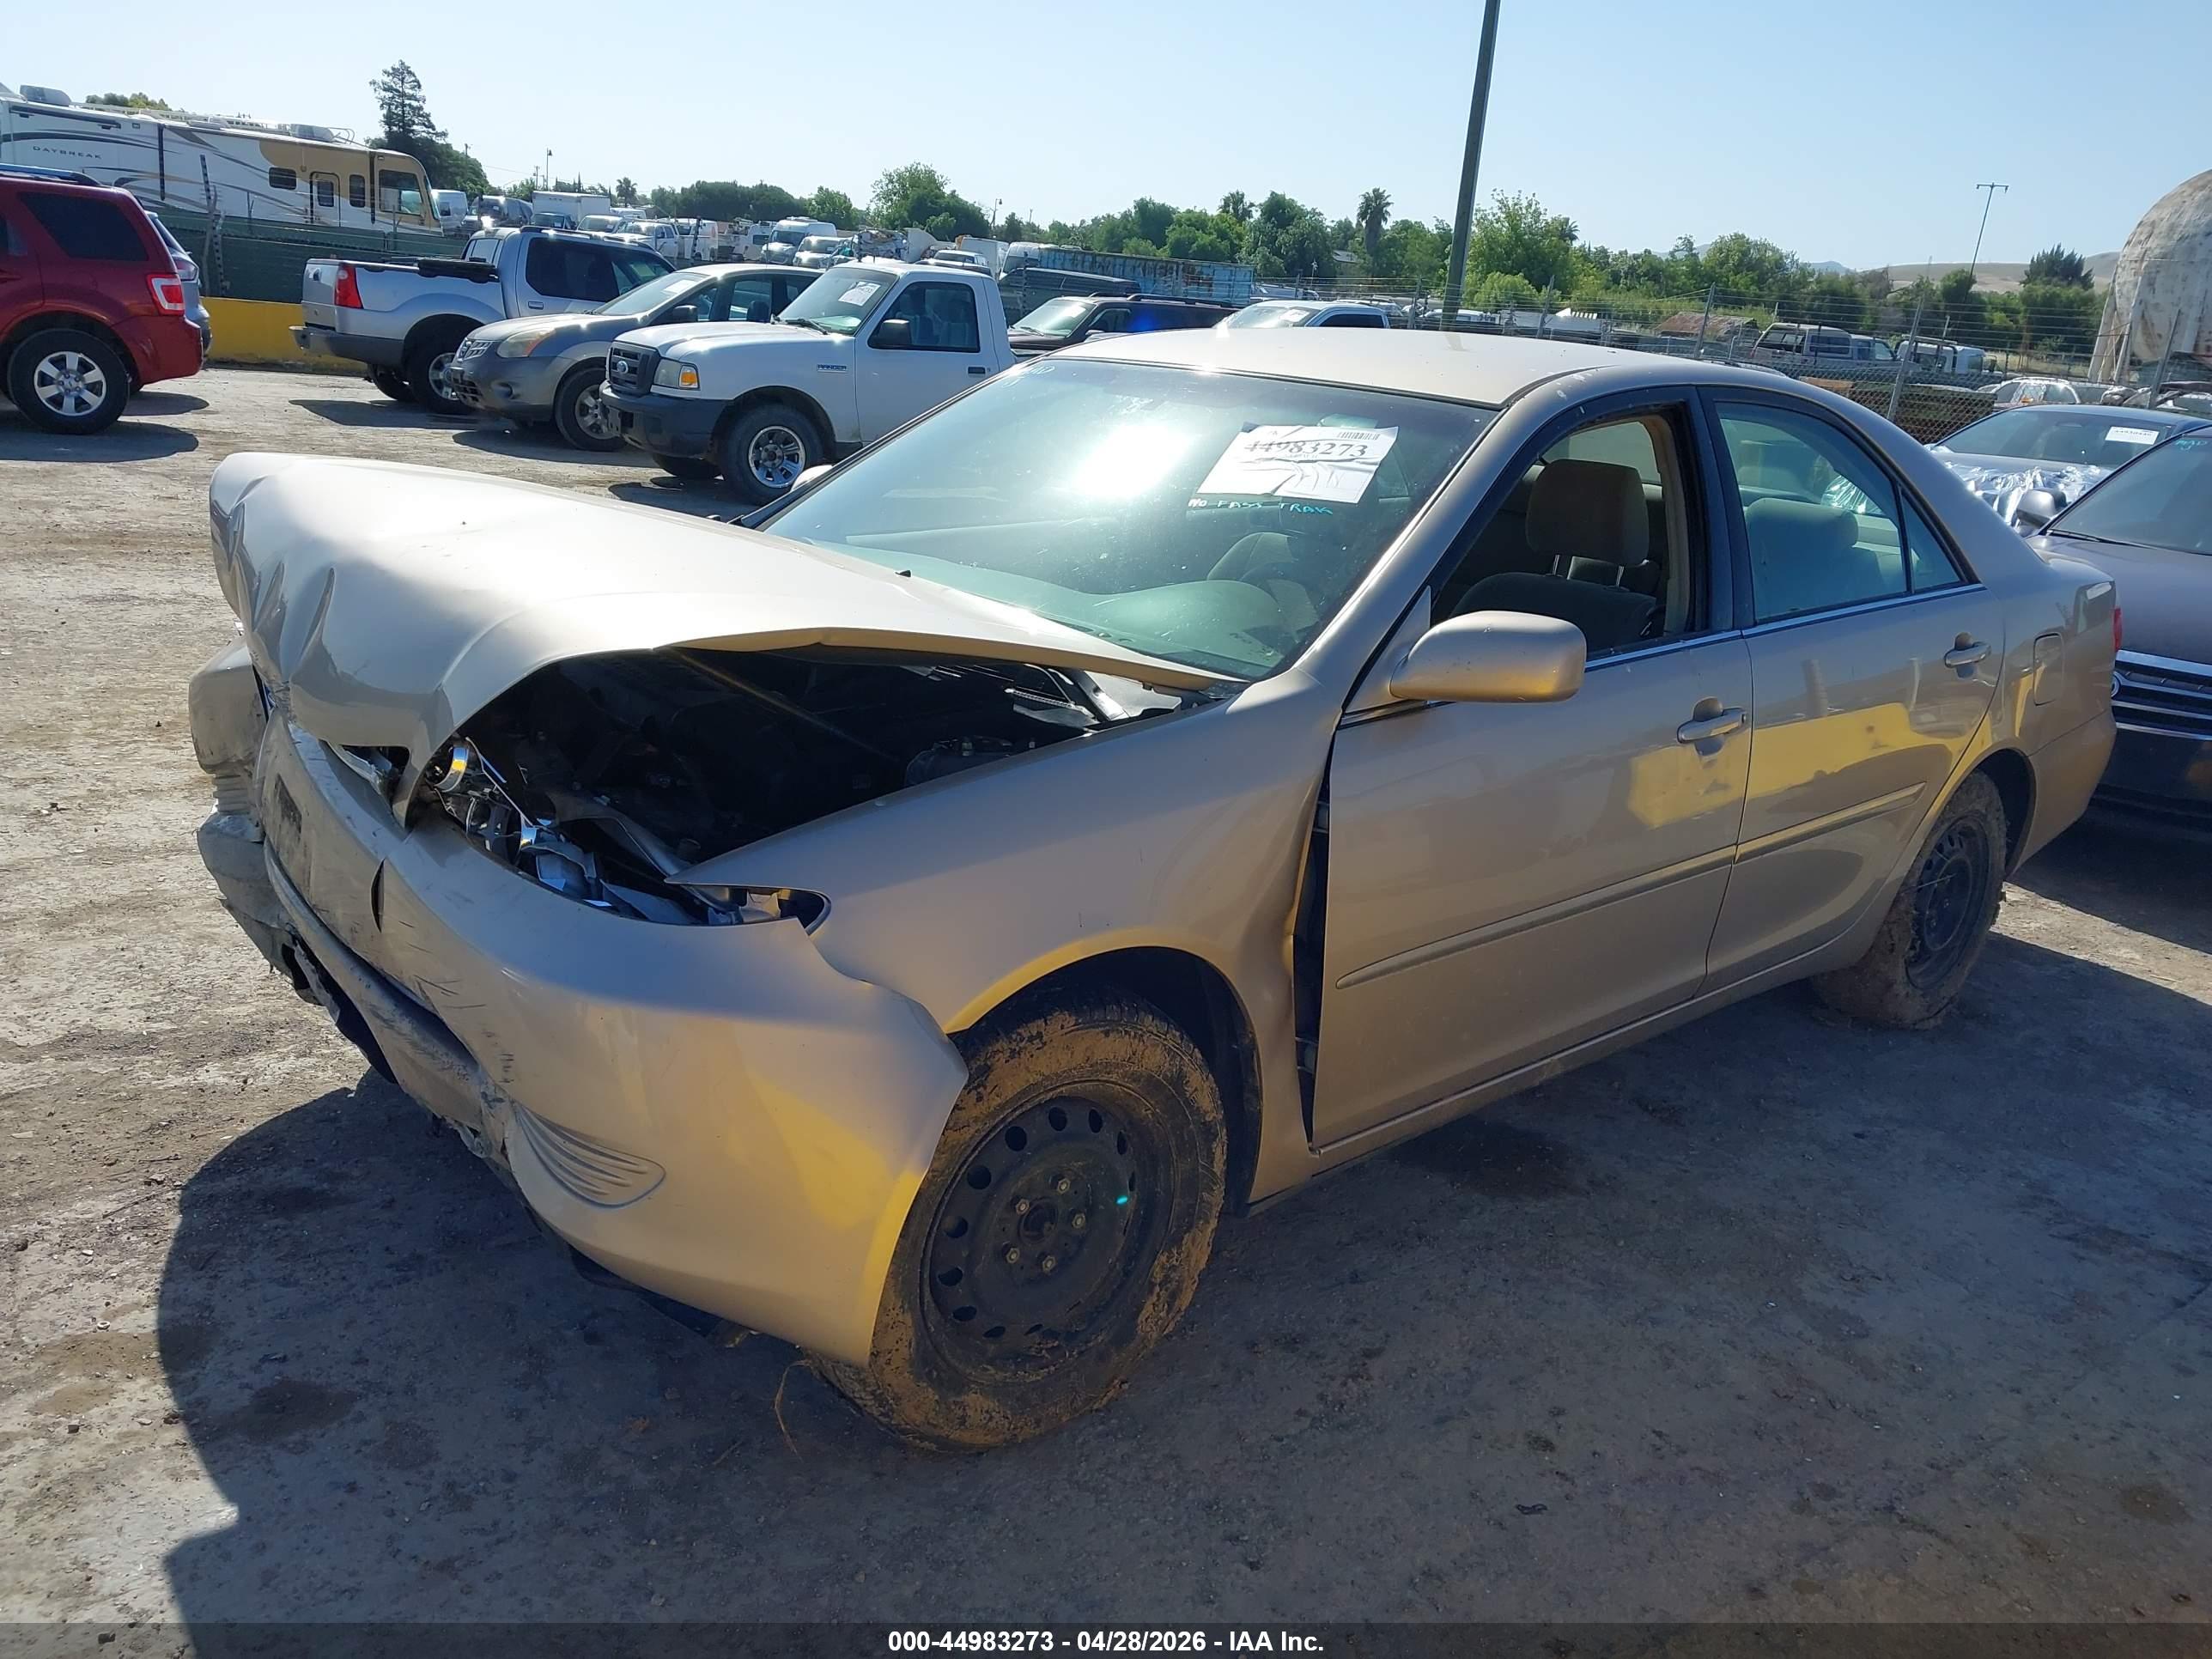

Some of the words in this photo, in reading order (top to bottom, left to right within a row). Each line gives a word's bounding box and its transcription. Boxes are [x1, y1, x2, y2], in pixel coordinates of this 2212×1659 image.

[33, 145, 102, 160] DAYBREAK
[1243, 441, 1368, 457] 44983273
[1188, 498, 1208, 508] NO
